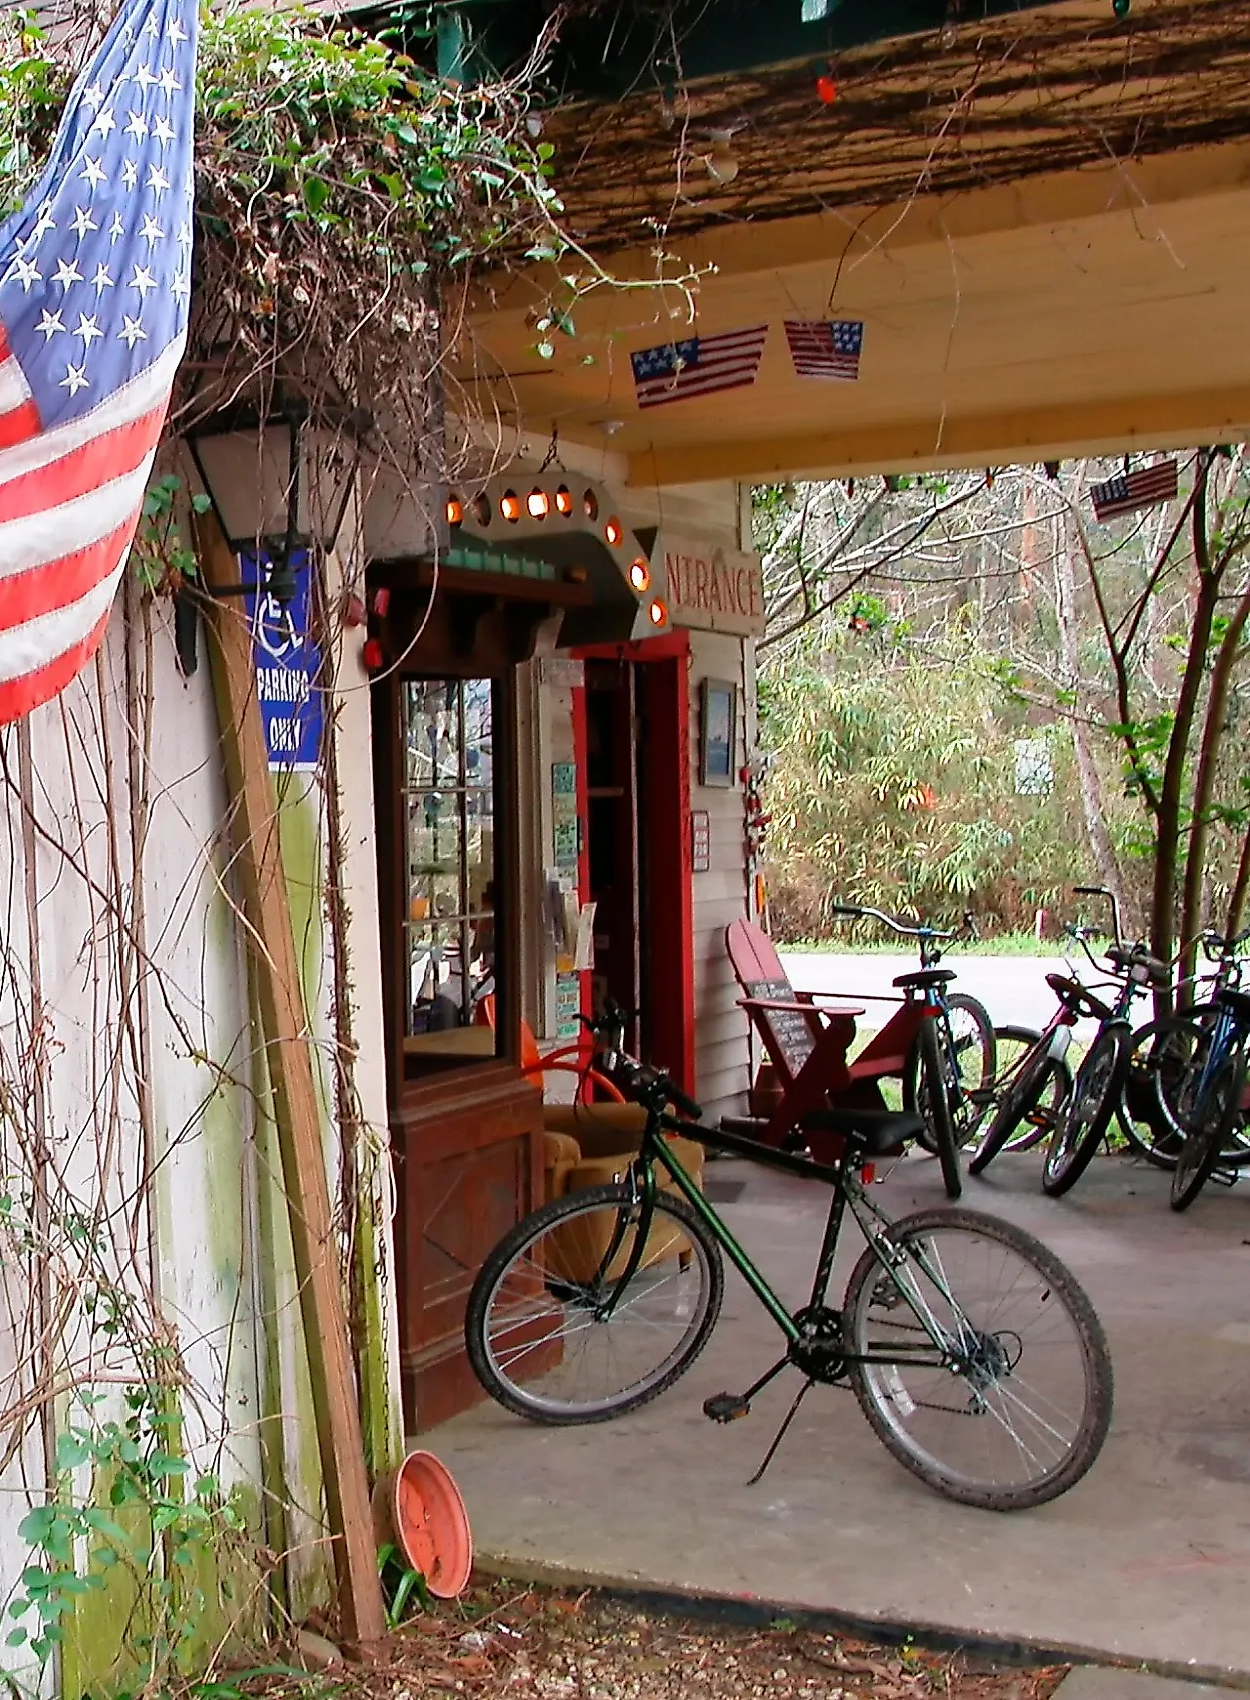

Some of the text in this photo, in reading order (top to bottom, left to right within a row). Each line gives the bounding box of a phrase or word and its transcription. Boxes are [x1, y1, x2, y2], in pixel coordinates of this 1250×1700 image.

[664, 552, 760, 617] NTRANCE
[257, 667, 310, 702] PARKING
[270, 717, 301, 751] ONLY
